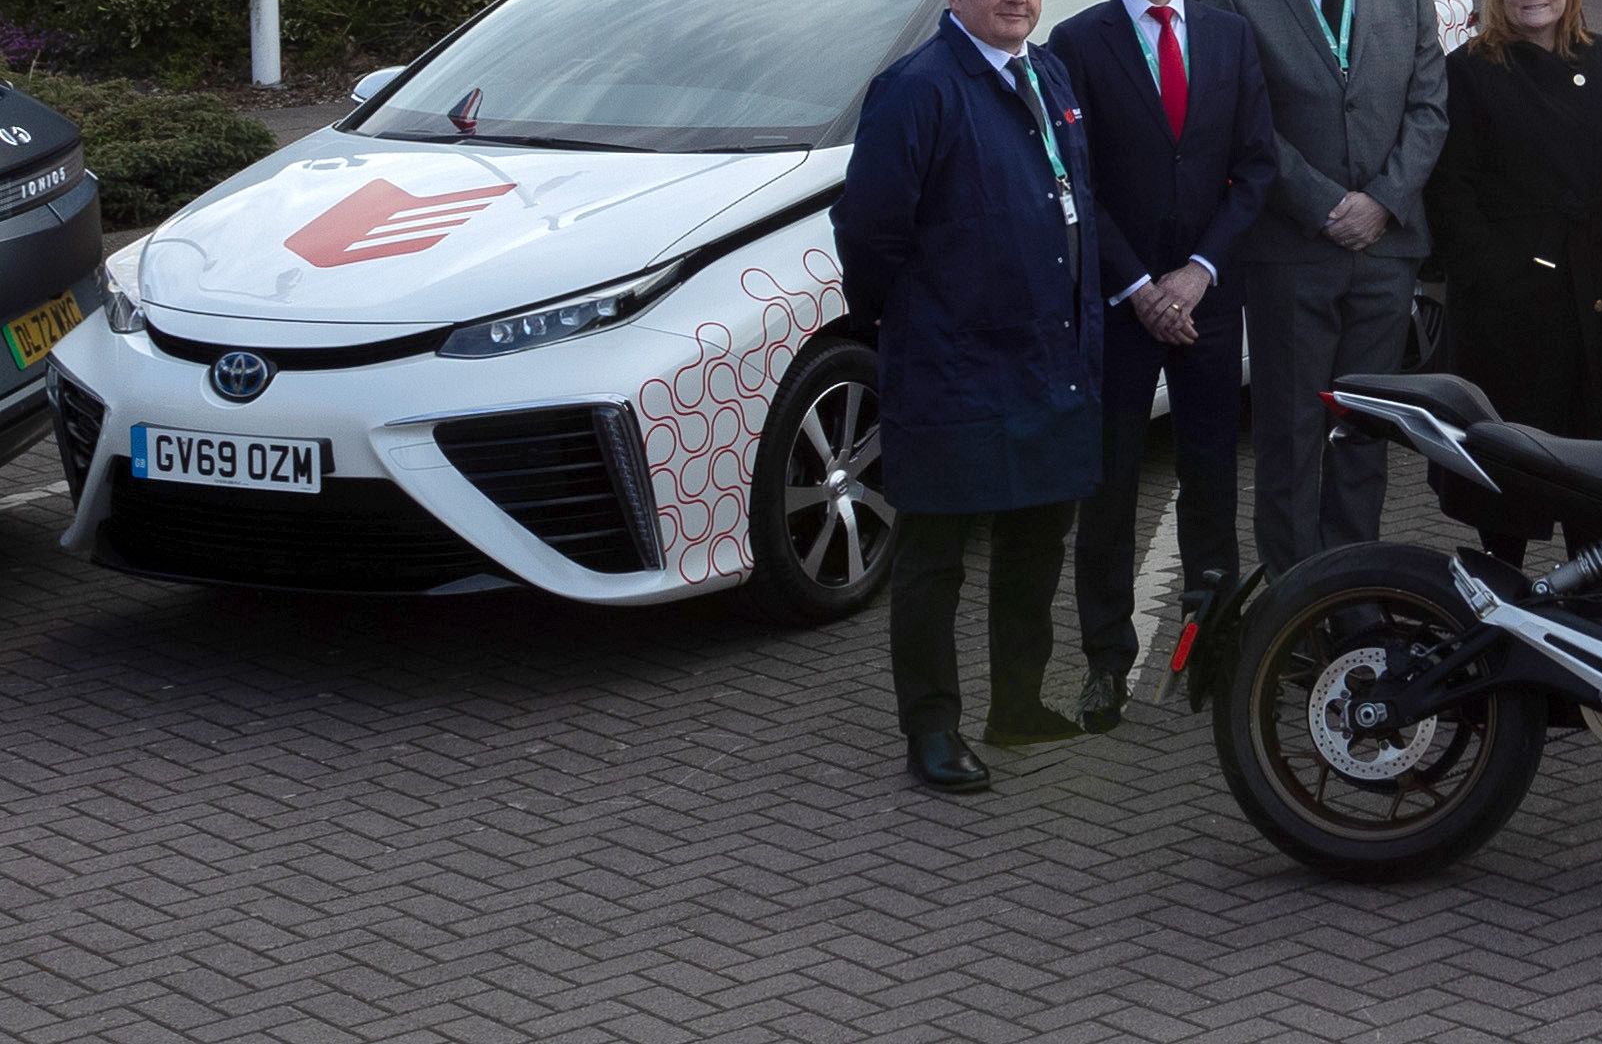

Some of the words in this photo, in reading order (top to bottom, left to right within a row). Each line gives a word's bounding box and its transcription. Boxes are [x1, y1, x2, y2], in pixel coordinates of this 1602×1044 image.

[14, 311, 58, 357] DL72
[49, 297, 82, 337] WXC
[155, 434, 237, 479] GV69
[247, 442, 314, 485] OZM
